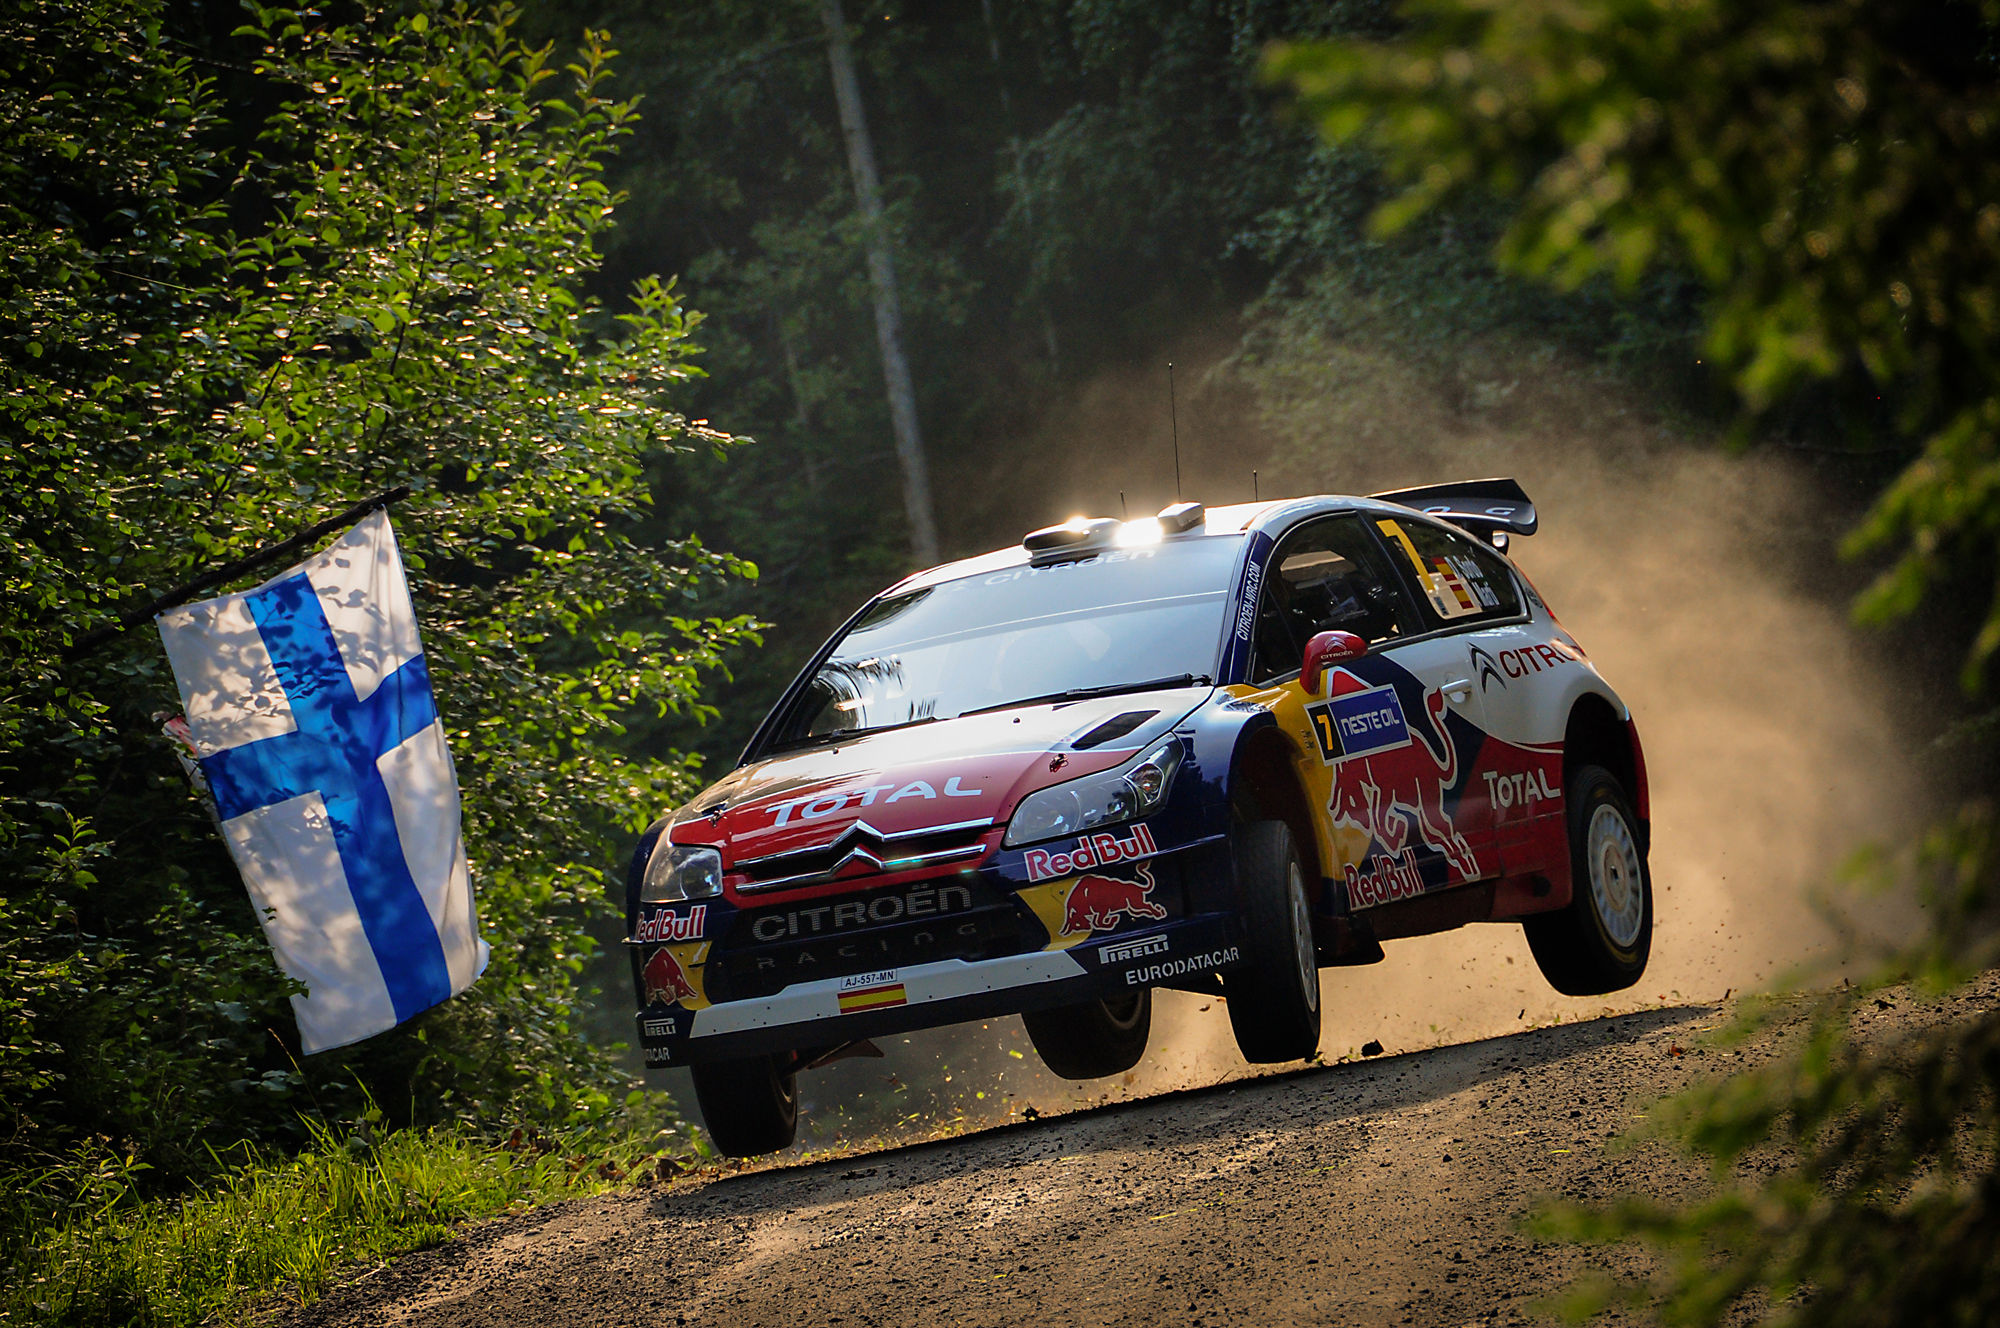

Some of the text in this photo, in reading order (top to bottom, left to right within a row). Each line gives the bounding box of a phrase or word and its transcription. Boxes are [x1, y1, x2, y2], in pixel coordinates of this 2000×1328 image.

[1376, 519, 1435, 590] 7
[1237, 560, 1261, 641] CITROEN-WRC.COM
[1499, 637, 1588, 679] CITR
[1316, 707, 1400, 751] 7 NESTE OIL
[765, 776, 983, 827] TOTAL
[1483, 768, 1561, 810] TOTAL
[1024, 822, 1158, 883] Red Bull
[1343, 846, 1425, 911] Red Bull
[656, 905, 707, 941] Bull
[1099, 934, 1169, 965] PIRELLI
[1125, 947, 1240, 985] EURODATACAR
[845, 970, 895, 987] AJ-557-MN
[644, 1017, 676, 1037] PIRELLI
